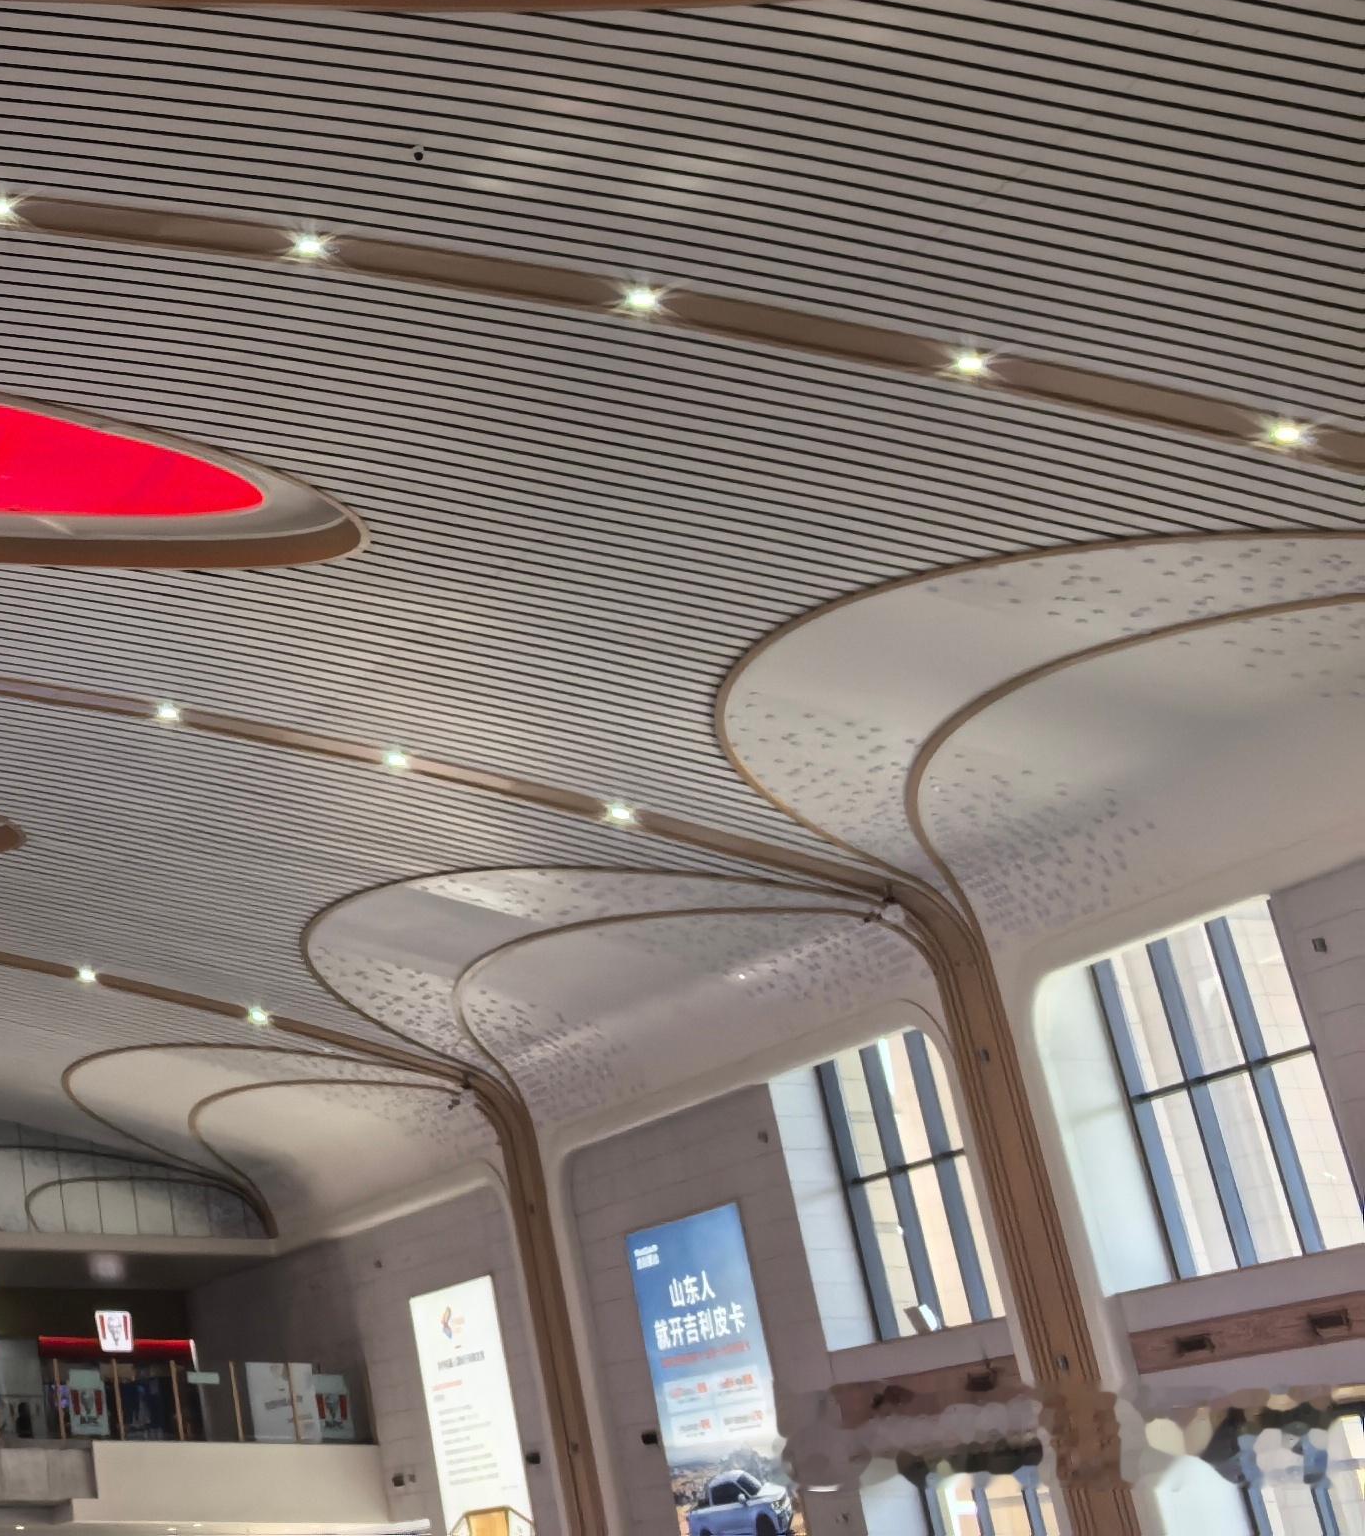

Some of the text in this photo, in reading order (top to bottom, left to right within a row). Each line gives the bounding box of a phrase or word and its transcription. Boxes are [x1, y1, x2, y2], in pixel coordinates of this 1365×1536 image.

[669, 1270, 716, 1308] 山东人
[654, 1302, 746, 1351] 就开吉利皮卡
